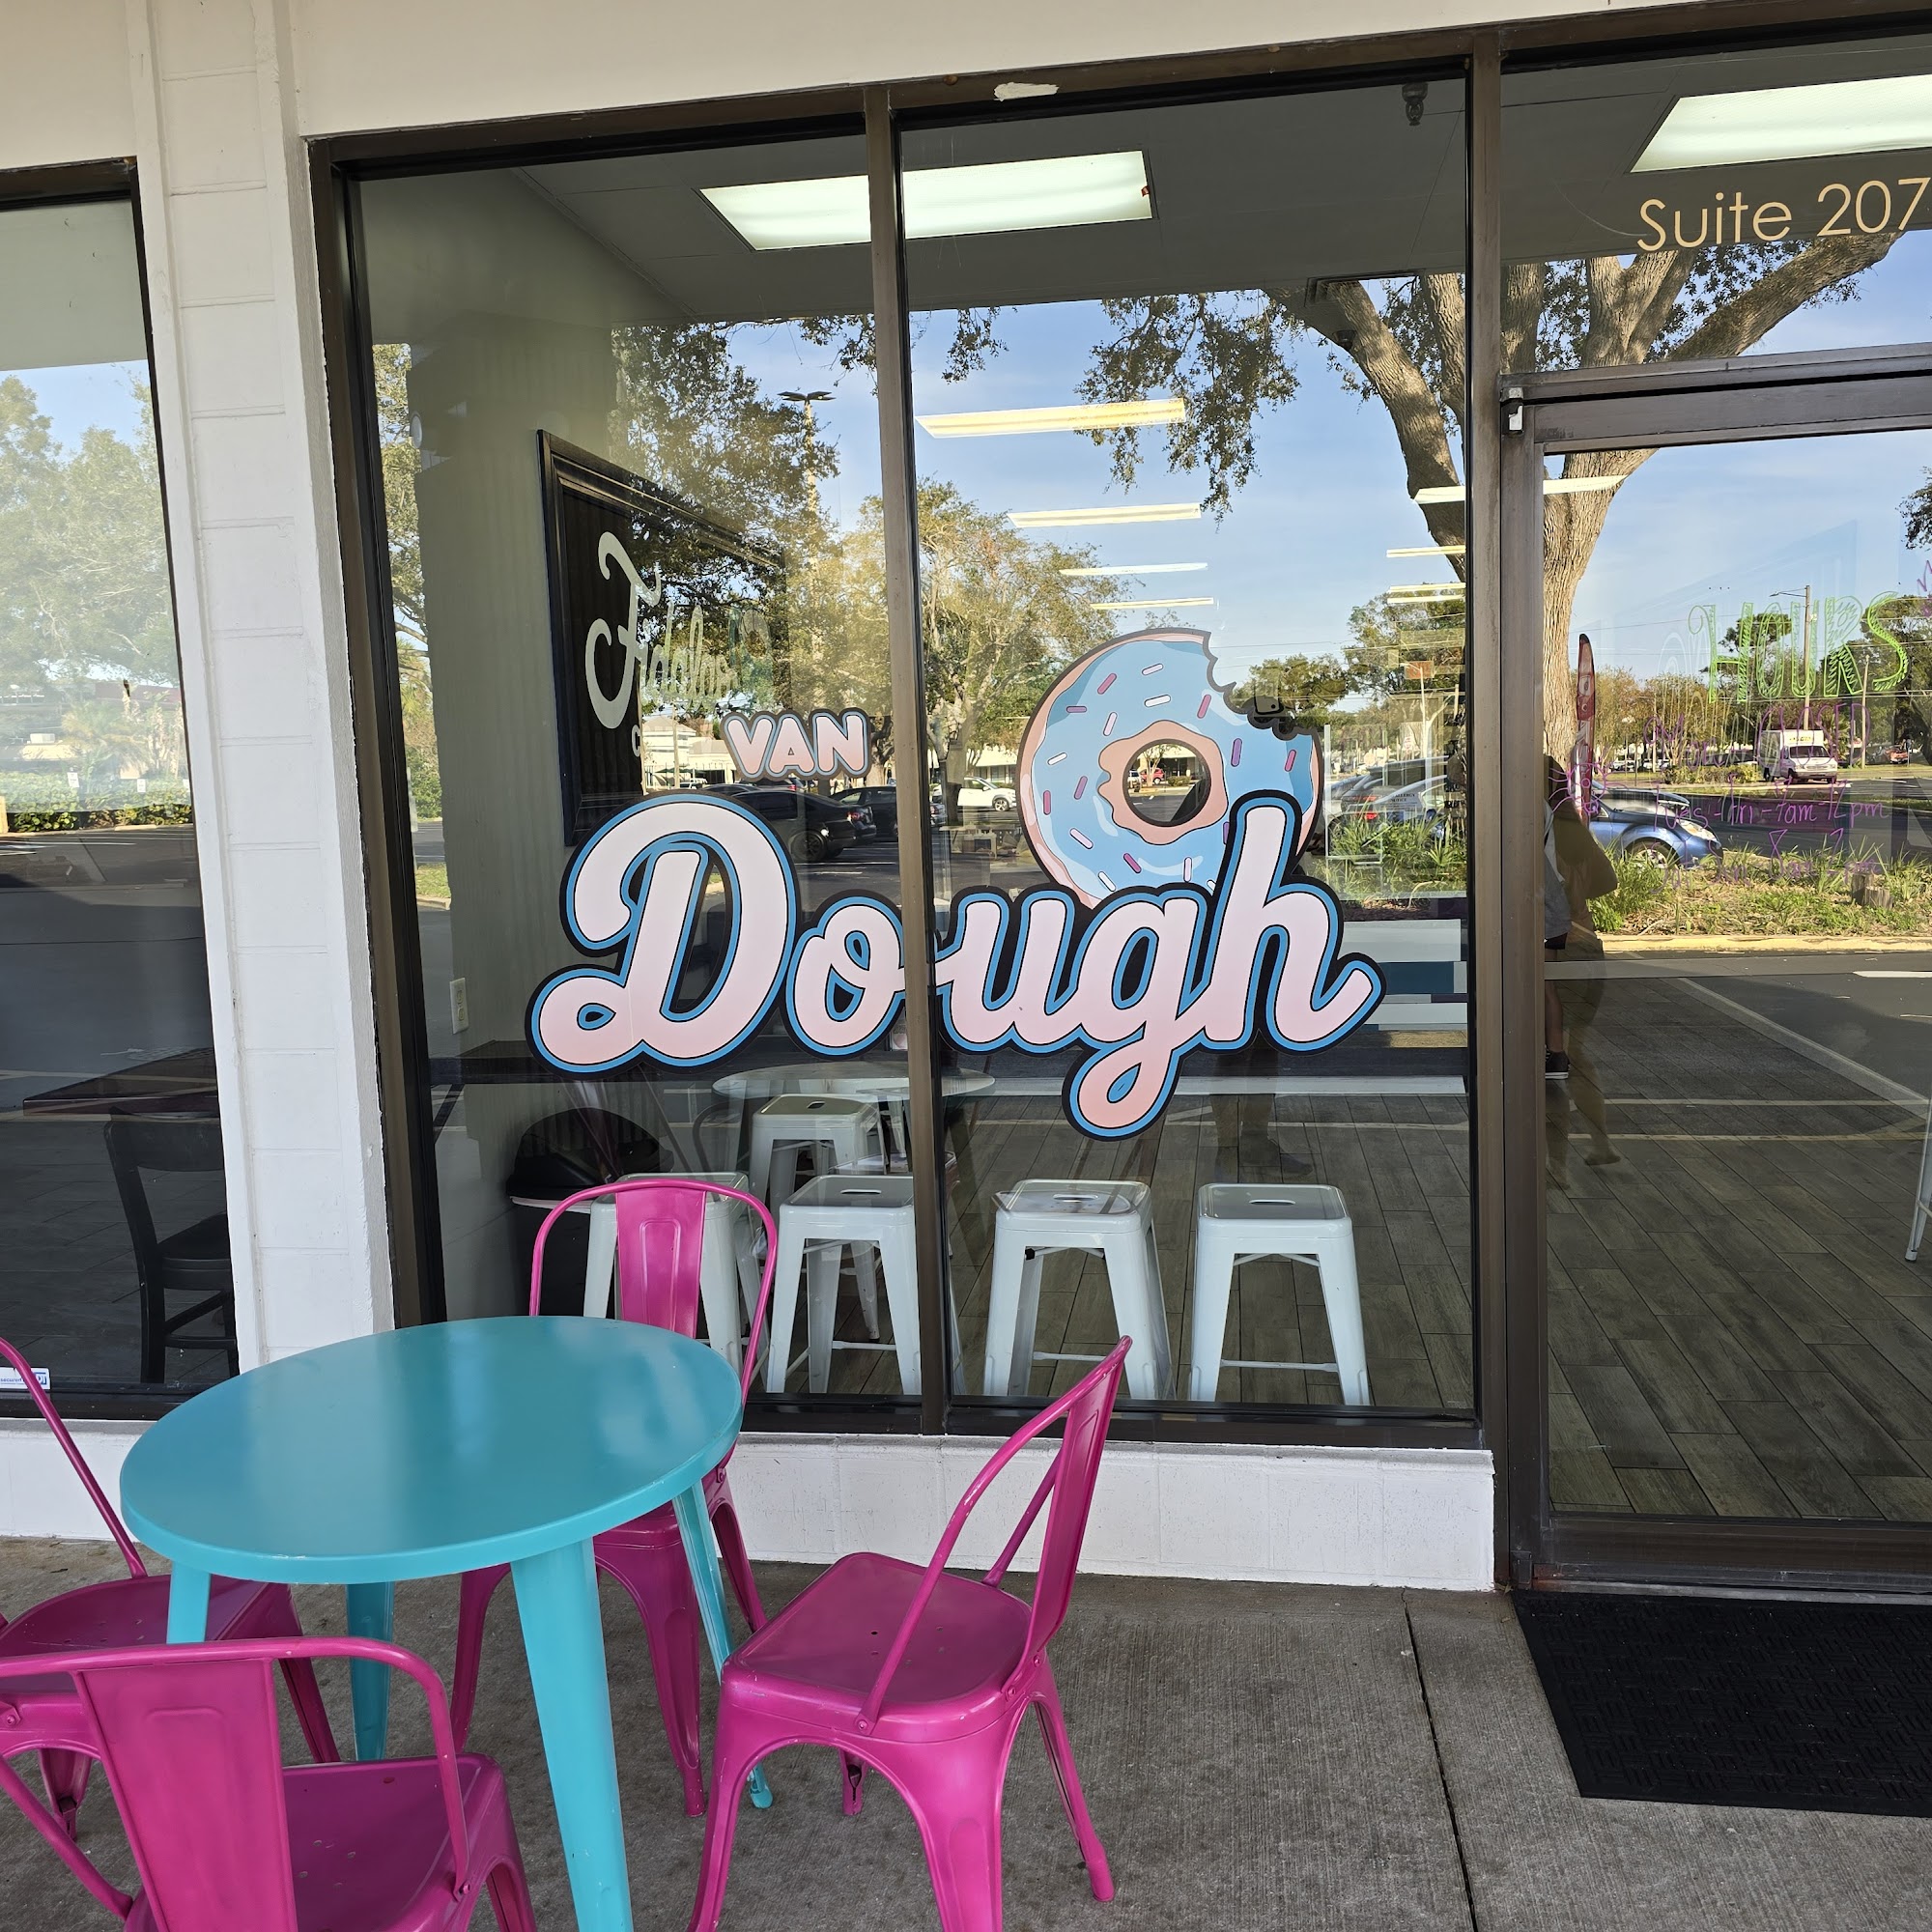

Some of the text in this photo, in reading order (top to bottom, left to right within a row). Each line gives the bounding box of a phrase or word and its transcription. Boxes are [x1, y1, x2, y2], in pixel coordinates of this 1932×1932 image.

[1637, 177, 1931, 251] Suite 207
[1688, 591, 1909, 703] HOURS
[722, 709, 871, 780] VAN
[527, 791, 1386, 1140] Dough
